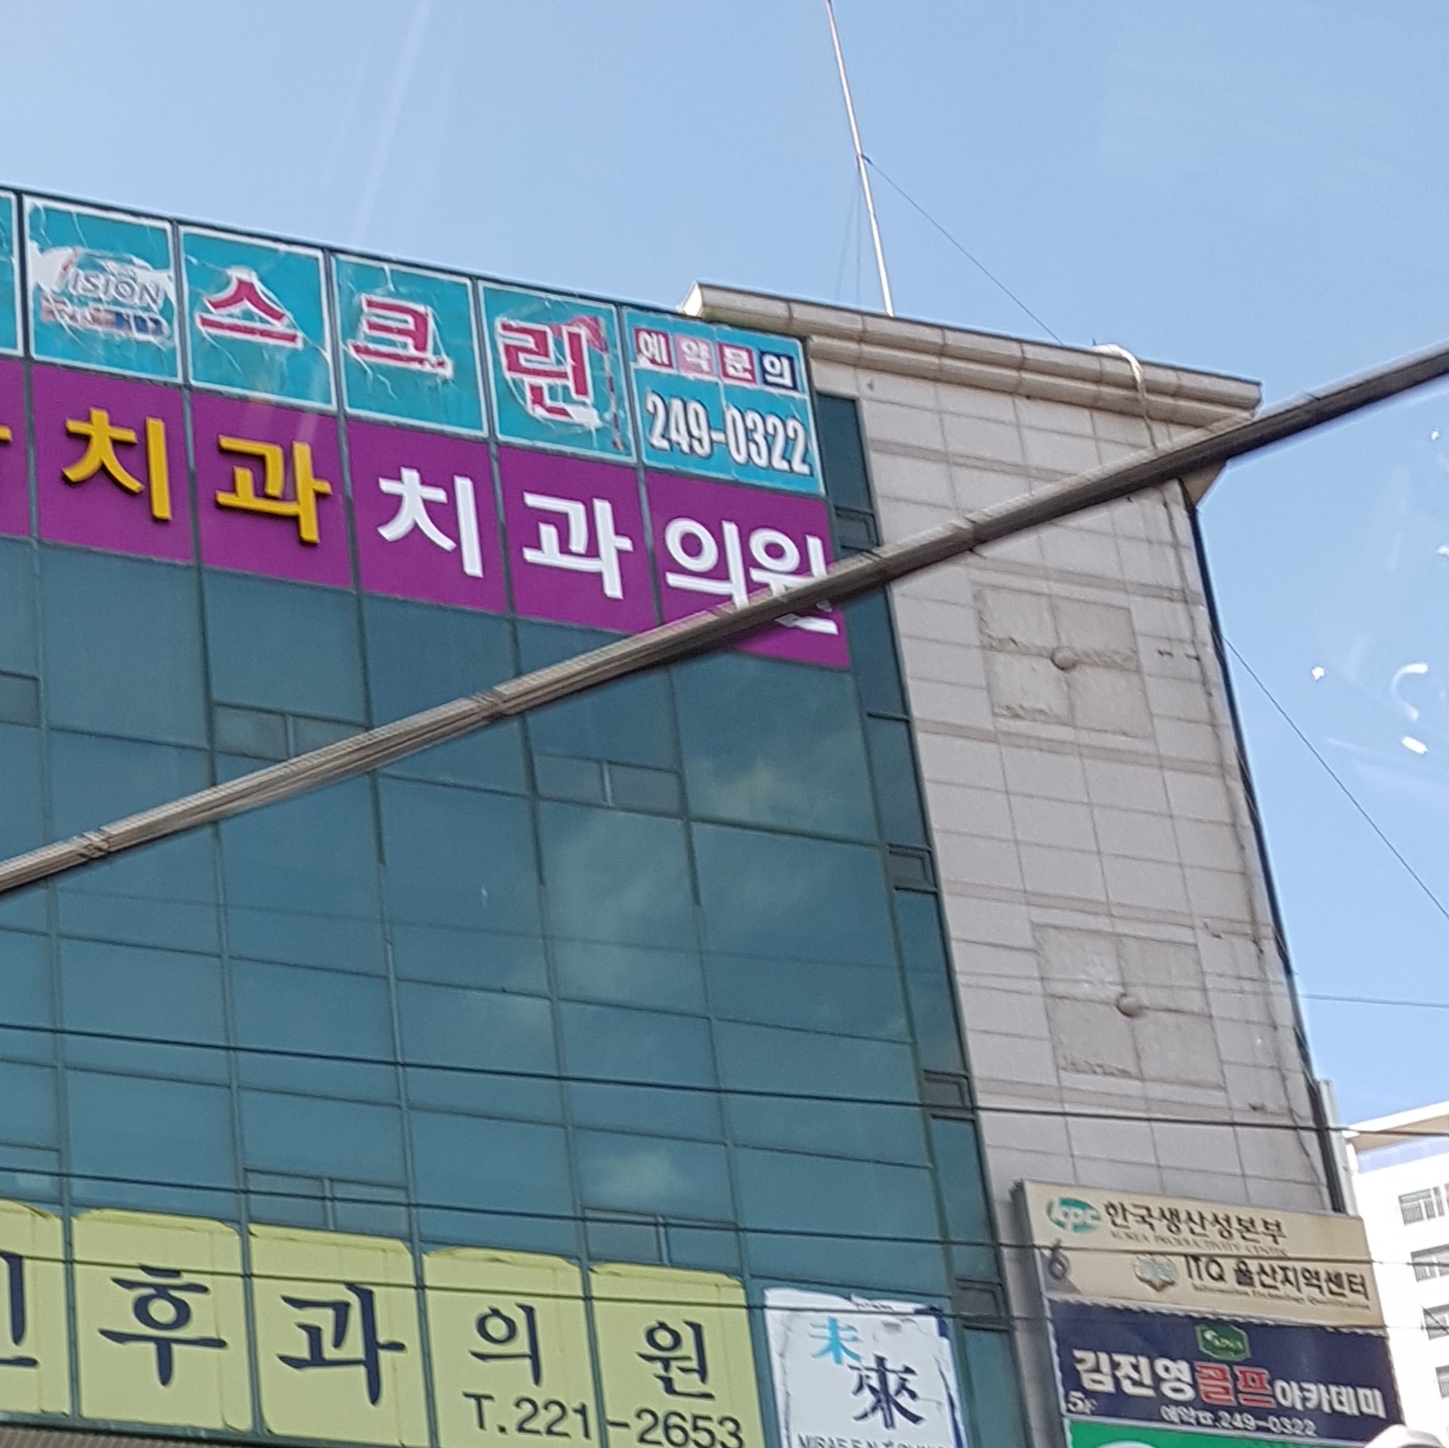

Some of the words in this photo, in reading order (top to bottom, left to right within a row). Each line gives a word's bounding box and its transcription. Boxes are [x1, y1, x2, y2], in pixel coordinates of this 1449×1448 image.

[645, 393, 812, 476] 249-0322
[1104, 1201, 1287, 1245] 한국생산성본부
[1234, 1260, 1370, 1301] 울산지역센터
